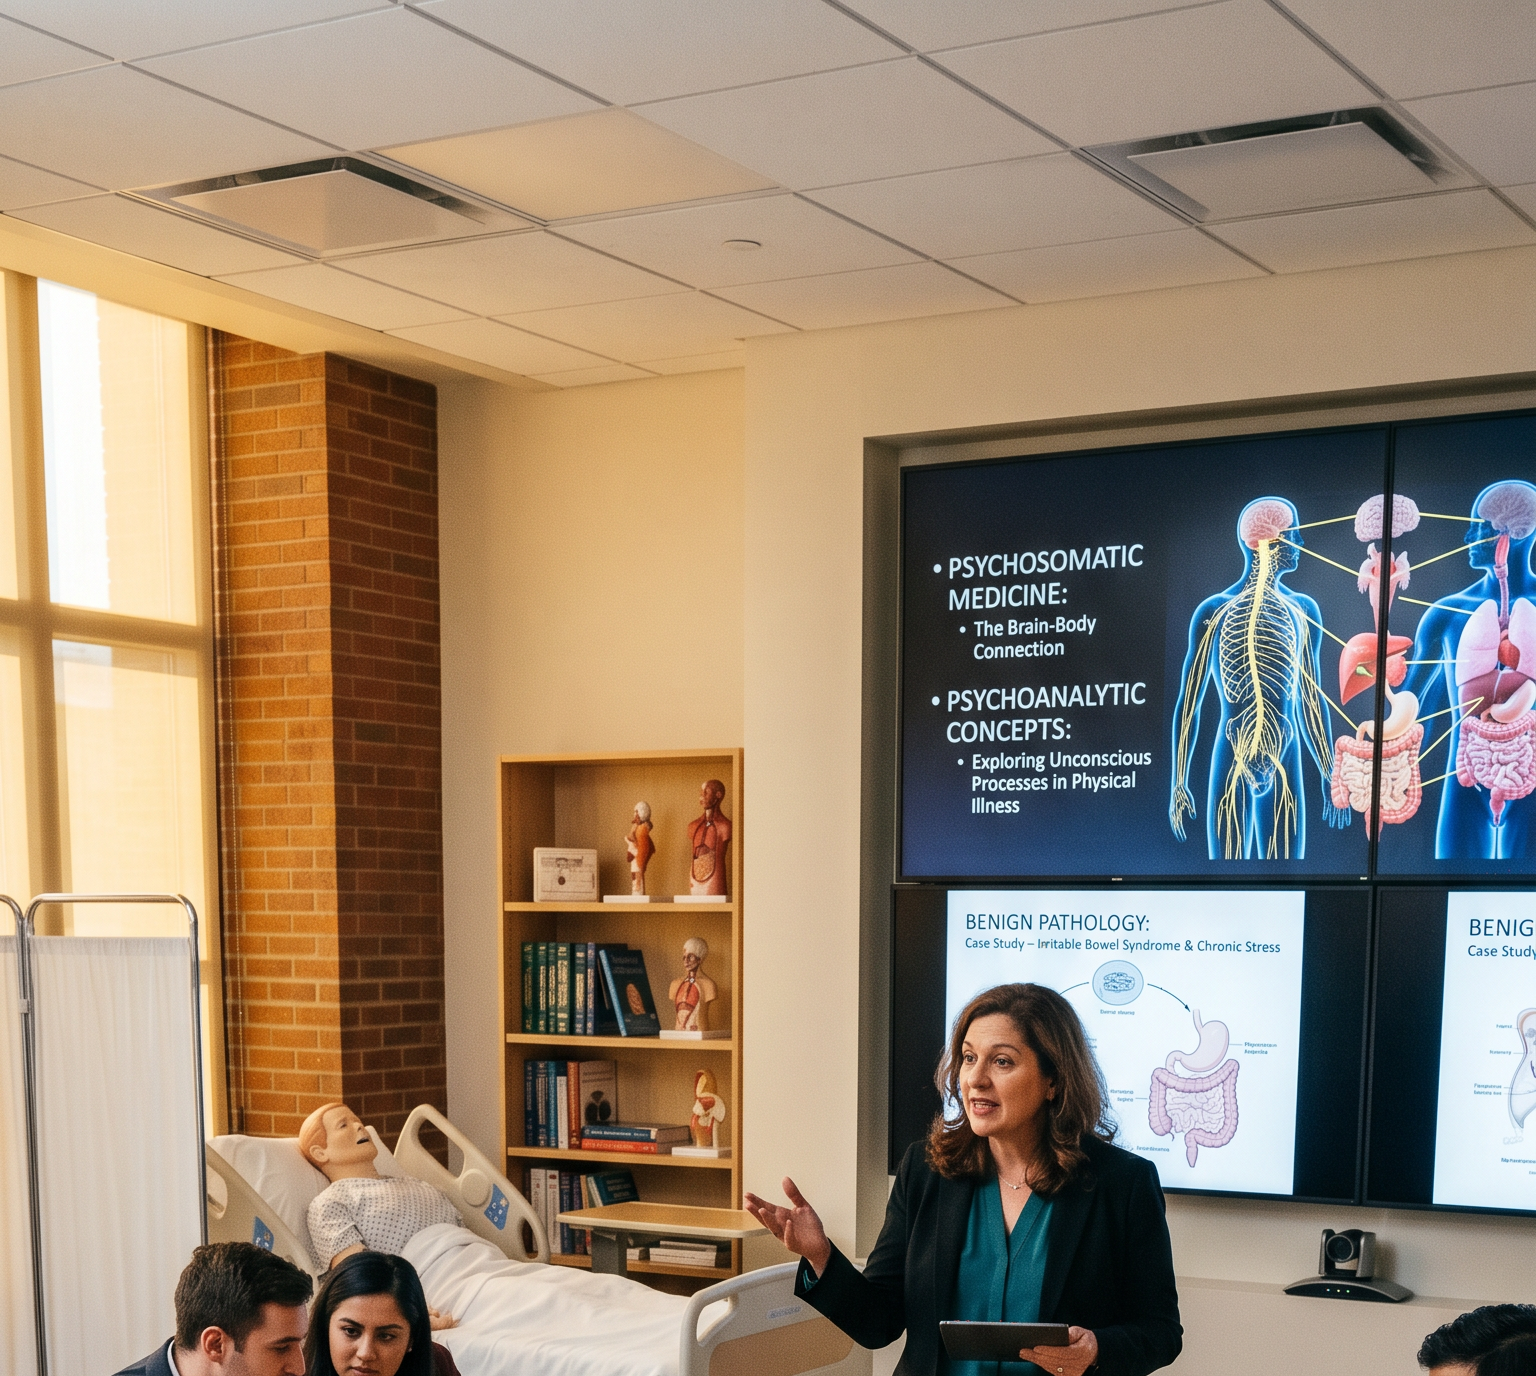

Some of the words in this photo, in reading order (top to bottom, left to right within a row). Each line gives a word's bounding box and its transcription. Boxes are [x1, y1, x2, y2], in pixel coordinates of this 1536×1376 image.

[949, 543, 1144, 580] PSYCHOSOMATIC
[949, 582, 1068, 611] MEDICINE:
[974, 619, 1004, 637] The
[1008, 614, 1097, 635] Brain-Body
[973, 640, 1065, 660] Connection
[947, 682, 1146, 712] PSYCHOANALYTIC
[946, 717, 1071, 743] CONCEPTS:
[972, 752, 1046, 774] Exploring
[1050, 749, 1152, 769] Unconscious
[971, 775, 1049, 792] Processes
[1052, 773, 1067, 790] in
[1072, 771, 1136, 793] Physical
[971, 797, 1020, 814] Illness
[966, 913, 1033, 931] BENIGN
[1039, 914, 1150, 932] PATHOLOGY:
[965, 937, 990, 949] Case
[993, 937, 1025, 952] Study
[1037, 938, 1082, 950] Irritable
[1085, 938, 1119, 950] Bowel
[1122, 939, 1181, 953] Syndrome
[1184, 939, 1194, 951] &
[1197, 940, 1242, 952] Chronic
[1245, 940, 1281, 953] Stress
[1467, 944, 1498, 957] Case
